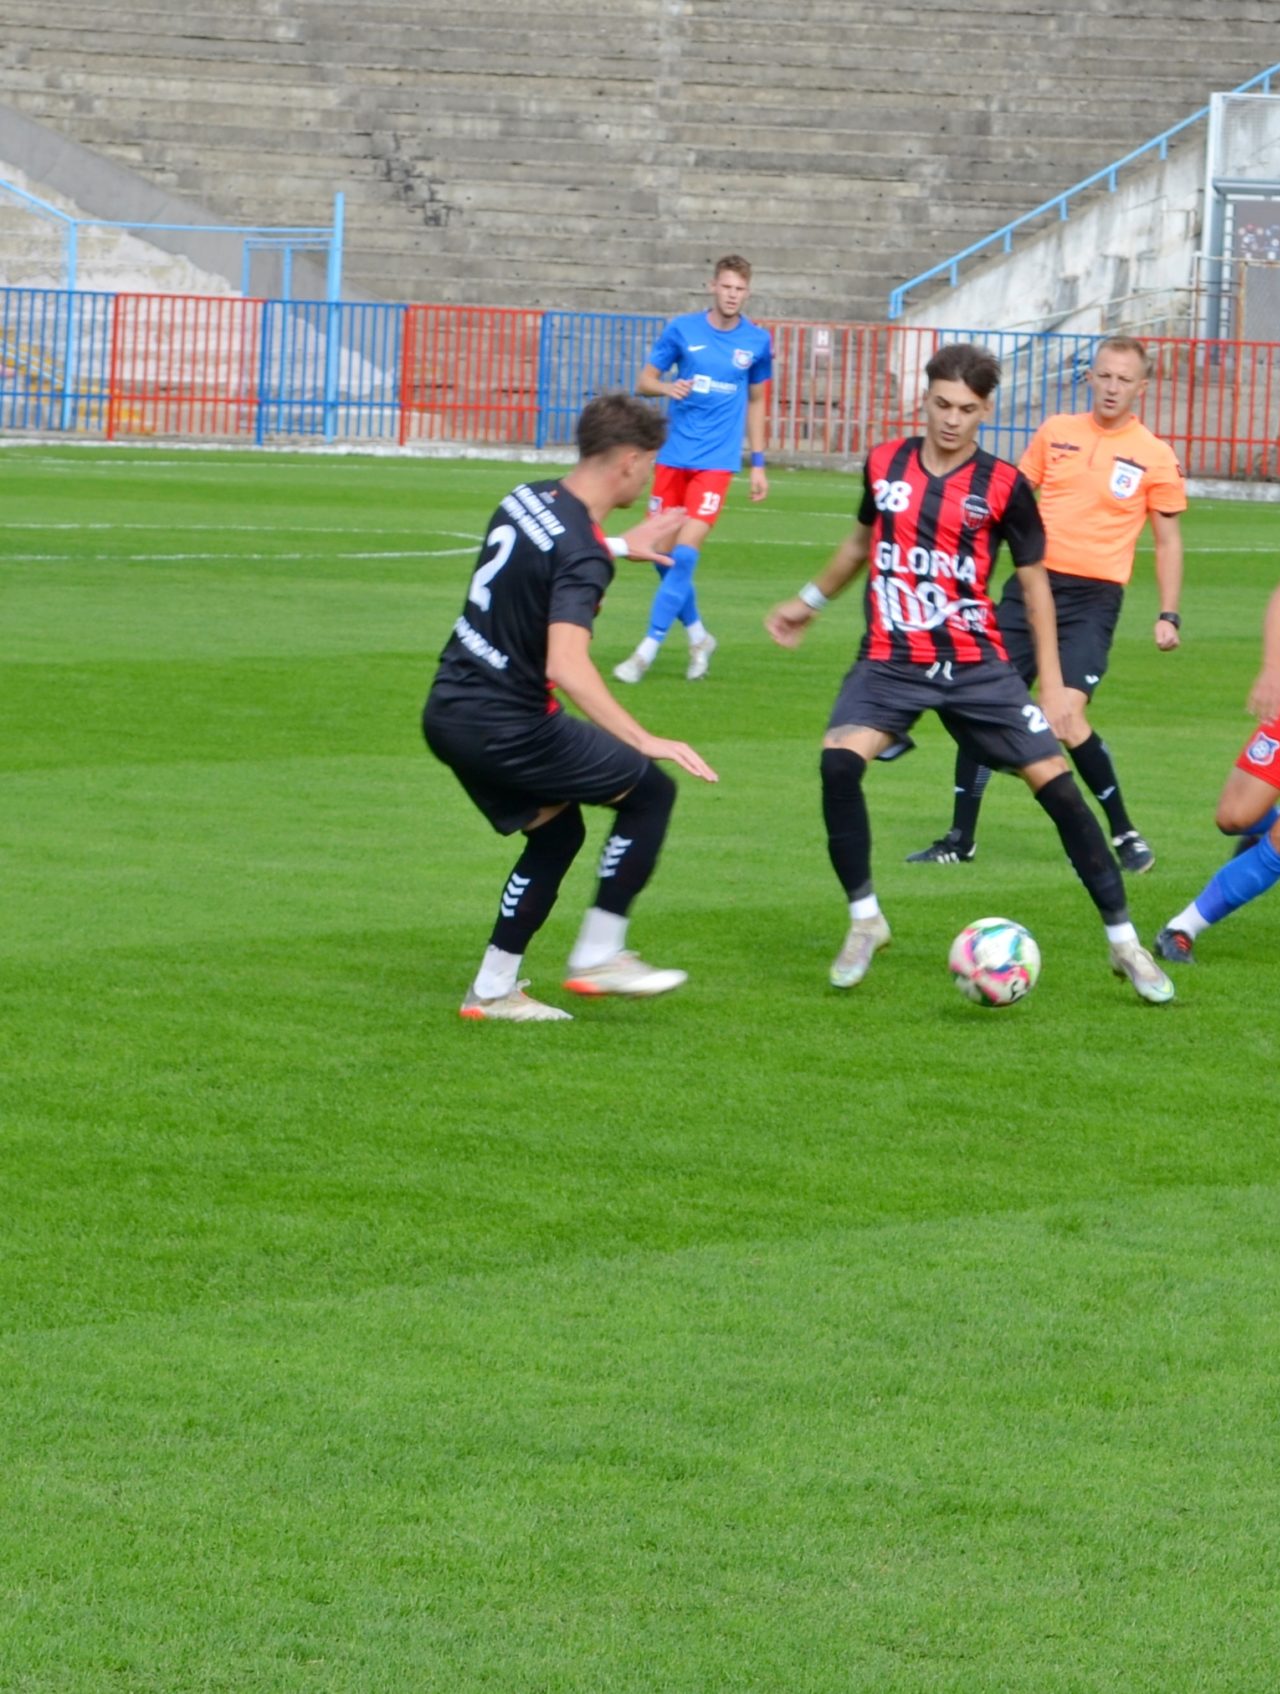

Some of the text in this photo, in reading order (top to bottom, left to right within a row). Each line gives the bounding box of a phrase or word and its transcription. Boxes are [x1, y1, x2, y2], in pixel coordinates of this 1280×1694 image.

[872, 479, 912, 512] 28
[468, 524, 517, 612] 2
[873, 541, 977, 584] GLORIA
